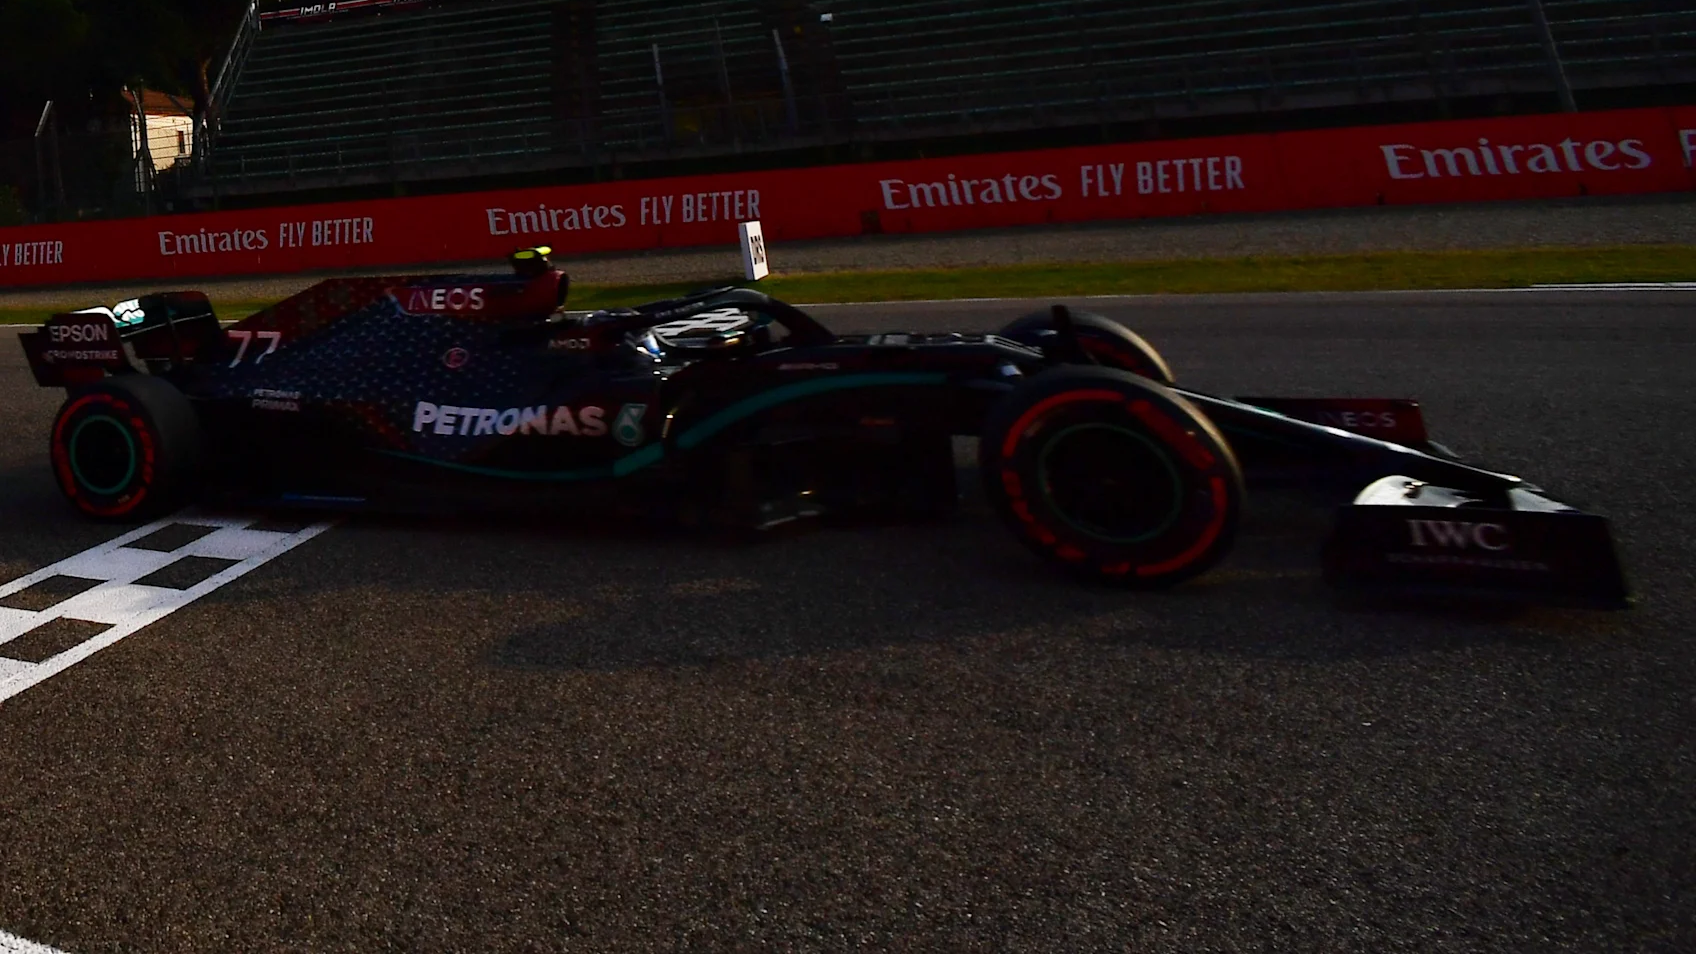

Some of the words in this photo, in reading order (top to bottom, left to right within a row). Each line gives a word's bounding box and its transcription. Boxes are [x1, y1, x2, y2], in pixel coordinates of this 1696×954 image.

[300, 2, 337, 16] IMOLA
[1380, 137, 1651, 179] Emirates
[879, 173, 1062, 210] Emirates
[1081, 162, 1125, 197] FLY
[1136, 155, 1245, 194] BETTER
[485, 203, 627, 236] Emirates
[640, 195, 674, 226] FLY
[682, 189, 762, 221] BETTER
[14, 240, 63, 266] BETTER
[157, 227, 269, 256] Emirates
[279, 221, 306, 248] FLY
[312, 217, 374, 246] BETTER
[408, 287, 486, 311] INEOS
[48, 324, 108, 342] EPSON
[227, 330, 282, 369] 77
[411, 400, 608, 437] PETRONAS
[1404, 518, 1509, 550] IWC
